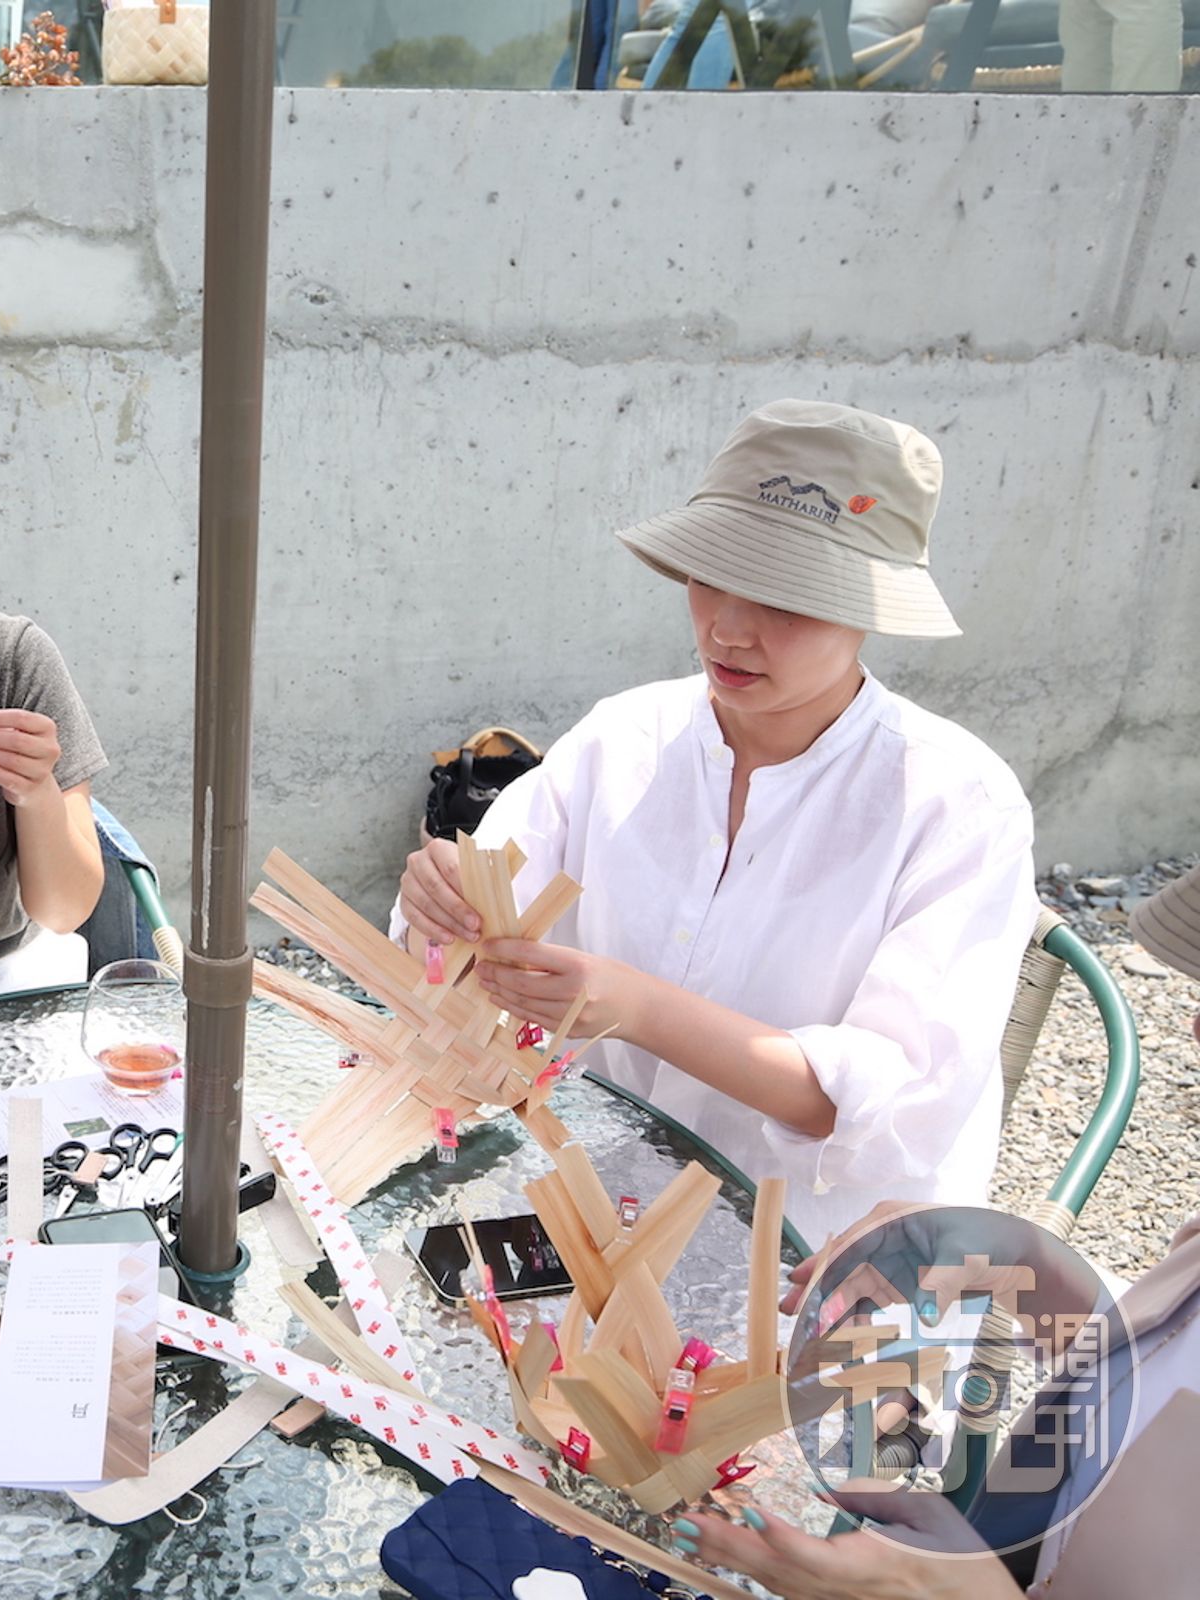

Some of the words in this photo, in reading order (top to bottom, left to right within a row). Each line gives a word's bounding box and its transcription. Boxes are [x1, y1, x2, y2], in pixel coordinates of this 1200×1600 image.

[757, 491, 840, 525] MATHARIRI
[367, 1321, 382, 1335] 3M
[384, 1344, 399, 1359] 3M
[383, 1426, 398, 1445] 3M
[417, 1442, 432, 1460] 3M
[451, 1459, 465, 1478] 3M
[503, 1453, 520, 1470] 3M
